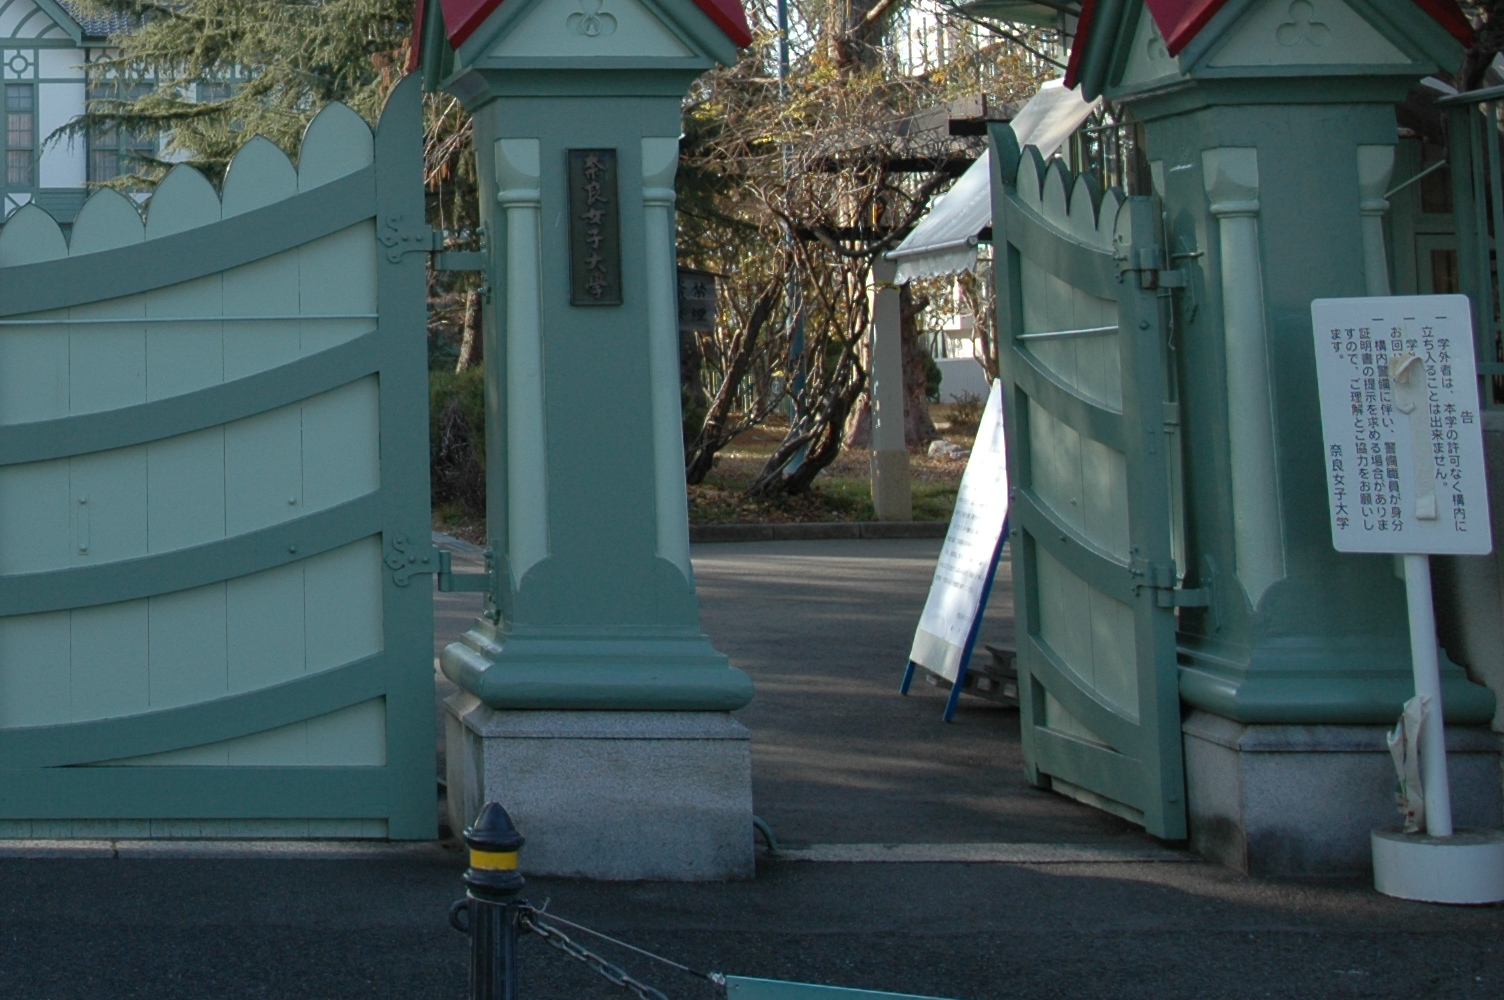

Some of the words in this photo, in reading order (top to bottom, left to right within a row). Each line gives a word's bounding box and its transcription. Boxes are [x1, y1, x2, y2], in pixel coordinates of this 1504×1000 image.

[691, 282, 707, 321] 禁煙
[1358, 327, 1389, 532] 証明書の提示を求める場合がありま
[1421, 326, 1448, 487] 立ち入ることは出来ません。
[1460, 410, 1474, 424] 告
[1329, 443, 1349, 530] 奈良女子大学
